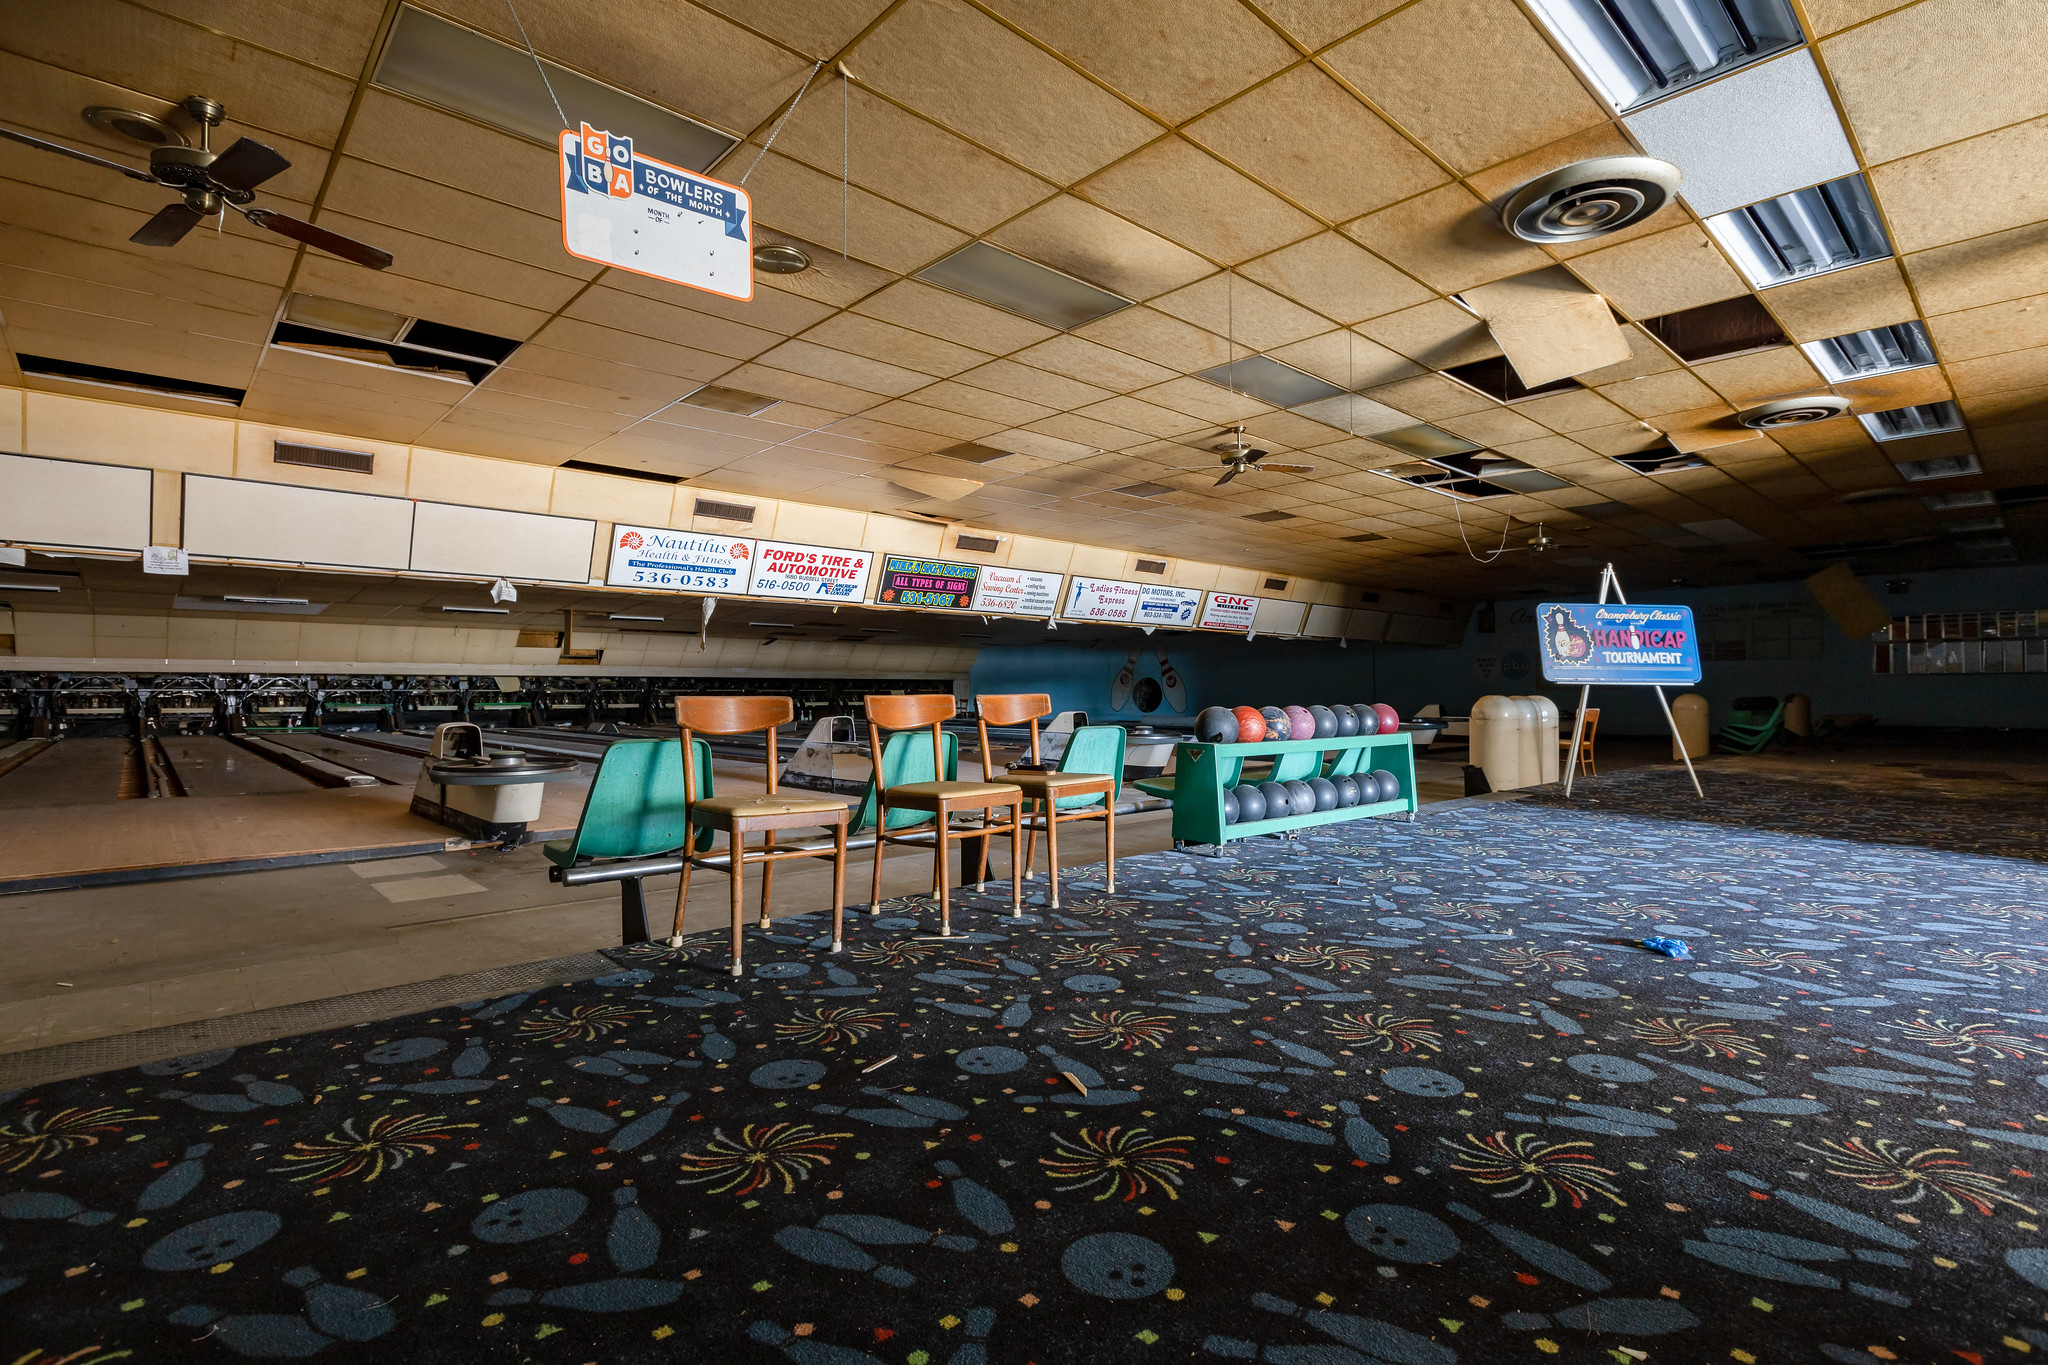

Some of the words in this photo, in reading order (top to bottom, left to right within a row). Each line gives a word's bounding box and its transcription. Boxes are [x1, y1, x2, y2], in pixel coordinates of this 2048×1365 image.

[645, 169, 724, 206] BOWLERS
[647, 185, 660, 196] OF
[665, 191, 683, 204] THE
[689, 199, 722, 217] MONTH
[647, 208, 670, 220] MONTH
[646, 535, 728, 554] Nautilus
[637, 549, 678, 561] Health
[682, 554, 690, 562] &
[692, 554, 733, 566] Fitness
[763, 549, 817, 564] FORD'S
[821, 555, 852, 567] TIRE
[854, 559, 864, 569] &
[647, 562, 694, 571] Professional's
[767, 562, 858, 579] AUTOMOTIVE
[888, 559, 921, 573] MIKE'S
[921, 562, 943, 575] SIGN
[943, 565, 977, 579] SHOPPE
[632, 571, 729, 588] 536-0583
[895, 577, 909, 586] ALL
[912, 578, 933, 588] TYPES
[935, 580, 945, 589] OF
[947, 582, 966, 591] SIGNS
[989, 571, 1015, 583] Vacuum
[1015, 575, 1022, 583] &
[756, 579, 810, 592] 516-0500
[981, 582, 1003, 595] Sewing
[1005, 584, 1024, 594] Center
[1090, 583, 1113, 593] Ladies
[1114, 586, 1138, 596] Fitness
[1151, 588, 1174, 597] MOTORS,
[900, 591, 955, 607] 531-5167
[1098, 595, 1125, 605] Express
[1214, 595, 1255, 607] GNC
[1090, 608, 1127, 618] 536-0585
[1595, 608, 1650, 624] Orangeburg
[1650, 610, 1682, 621] Classic
[1594, 629, 1687, 649] HANDICAP
[1603, 651, 1682, 664] TOURNAMENT
